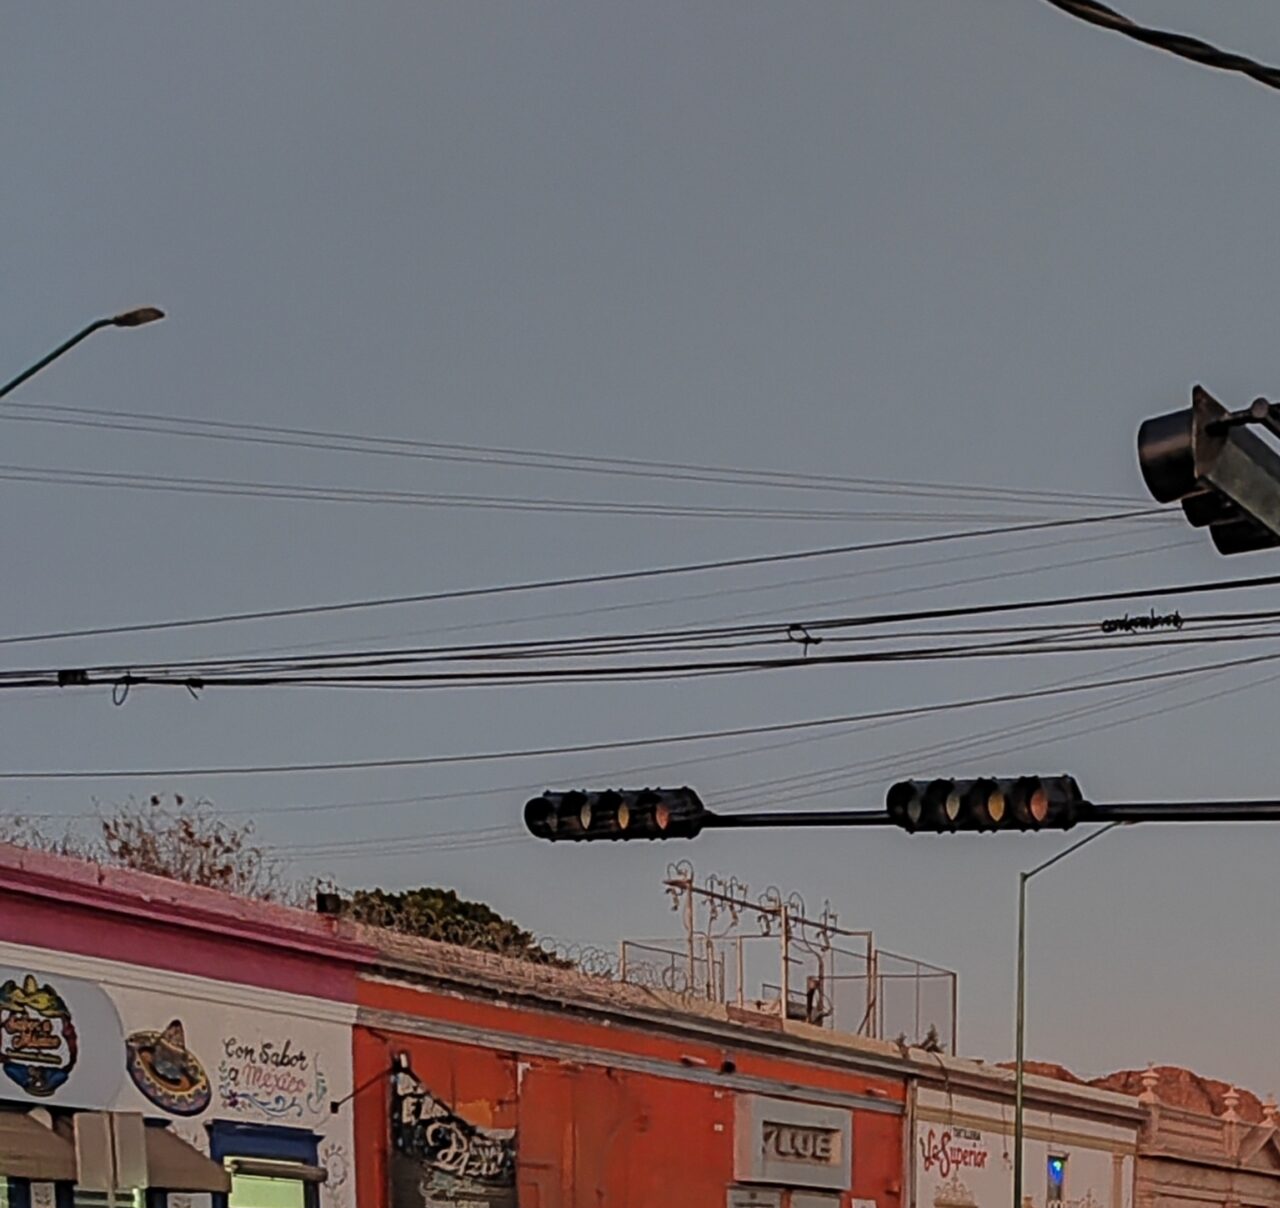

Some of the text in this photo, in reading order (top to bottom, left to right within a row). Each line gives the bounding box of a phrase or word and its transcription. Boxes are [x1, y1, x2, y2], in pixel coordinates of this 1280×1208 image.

[222, 1037, 308, 1071] Con Sabor
[228, 1067, 239, 1081] a
[940, 1131, 988, 1178] Superior
